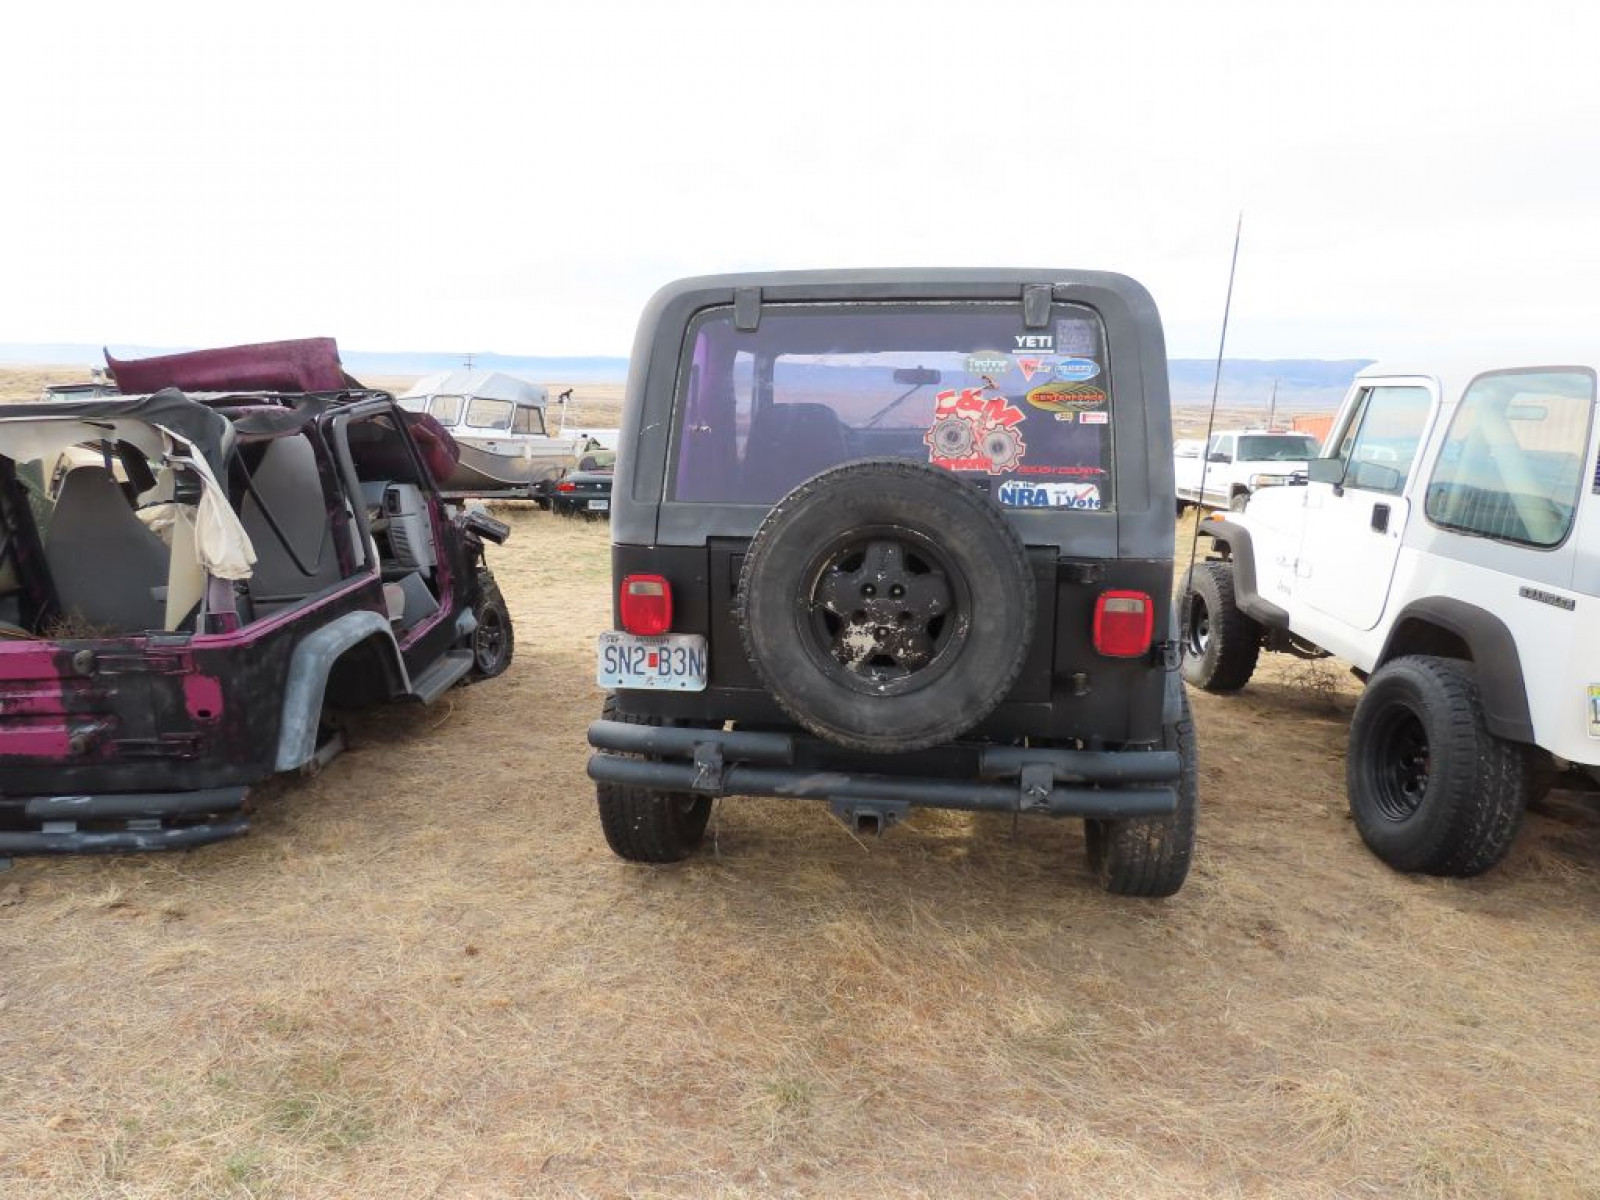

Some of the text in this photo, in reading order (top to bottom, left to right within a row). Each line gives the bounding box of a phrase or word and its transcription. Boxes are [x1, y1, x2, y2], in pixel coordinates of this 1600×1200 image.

[1014, 335, 1053, 348] YETI
[1000, 488, 1049, 506] NRA
[1065, 495, 1101, 508] Vote
[604, 645, 701, 676] SN2 B3N
